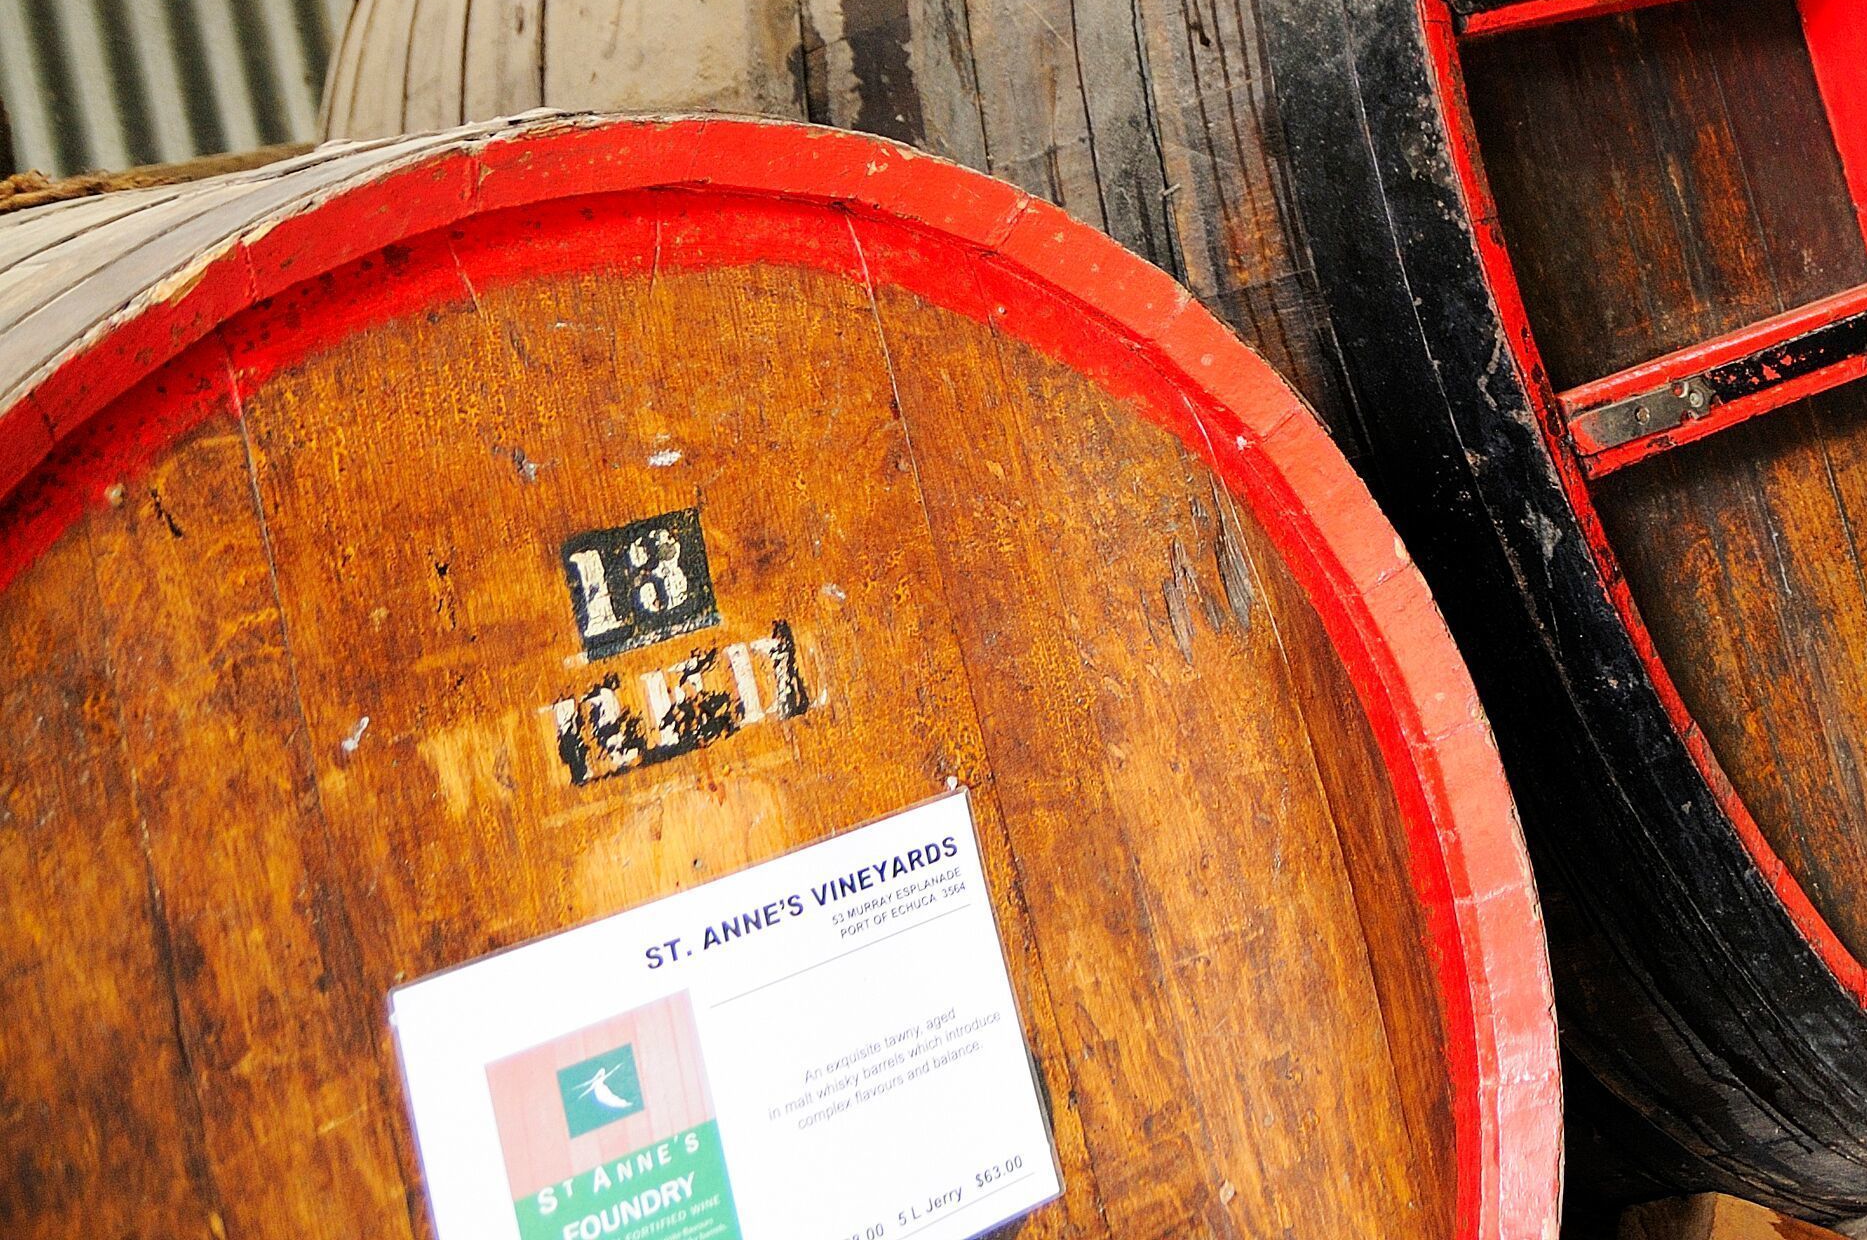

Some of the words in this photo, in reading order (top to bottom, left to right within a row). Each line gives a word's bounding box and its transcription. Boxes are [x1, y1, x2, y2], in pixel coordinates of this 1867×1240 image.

[645, 937, 693, 970] ST.
[703, 894, 804, 950] ANNE'S
[810, 836, 958, 906] VINEYARDS
[831, 912, 846, 926] 53
[846, 892, 894, 920] MURRAY
[895, 866, 962, 901] ESPLANADE
[840, 919, 871, 940] PORT
[872, 911, 889, 926] OF
[891, 893, 938, 920] ECHUCA
[941, 881, 967, 899] 3564
[768, 1105, 781, 1122] in
[785, 1086, 814, 1115] malt
[816, 1071, 861, 1101] whisky
[863, 1052, 906, 1081] barrels
[908, 1033, 944, 1060] which
[945, 1009, 1001, 1043] introduce
[804, 1066, 823, 1085] An
[826, 1041, 882, 1075] exquisite
[884, 1024, 924, 1050] tawny,
[926, 1006, 957, 1034] aged
[797, 1097, 852, 1131] complex
[854, 1072, 905, 1105] flavours
[907, 1062, 931, 1082] and
[933, 1038, 984, 1069] balance.
[592, 1131, 700, 1194] ANNE'S
[898, 1211, 908, 1227] 5
[911, 1206, 922, 1221] L
[925, 1186, 963, 1214] Jerry
[974, 1154, 1024, 1189] $63.00
[561, 1171, 695, 1240] FOUNDRY
